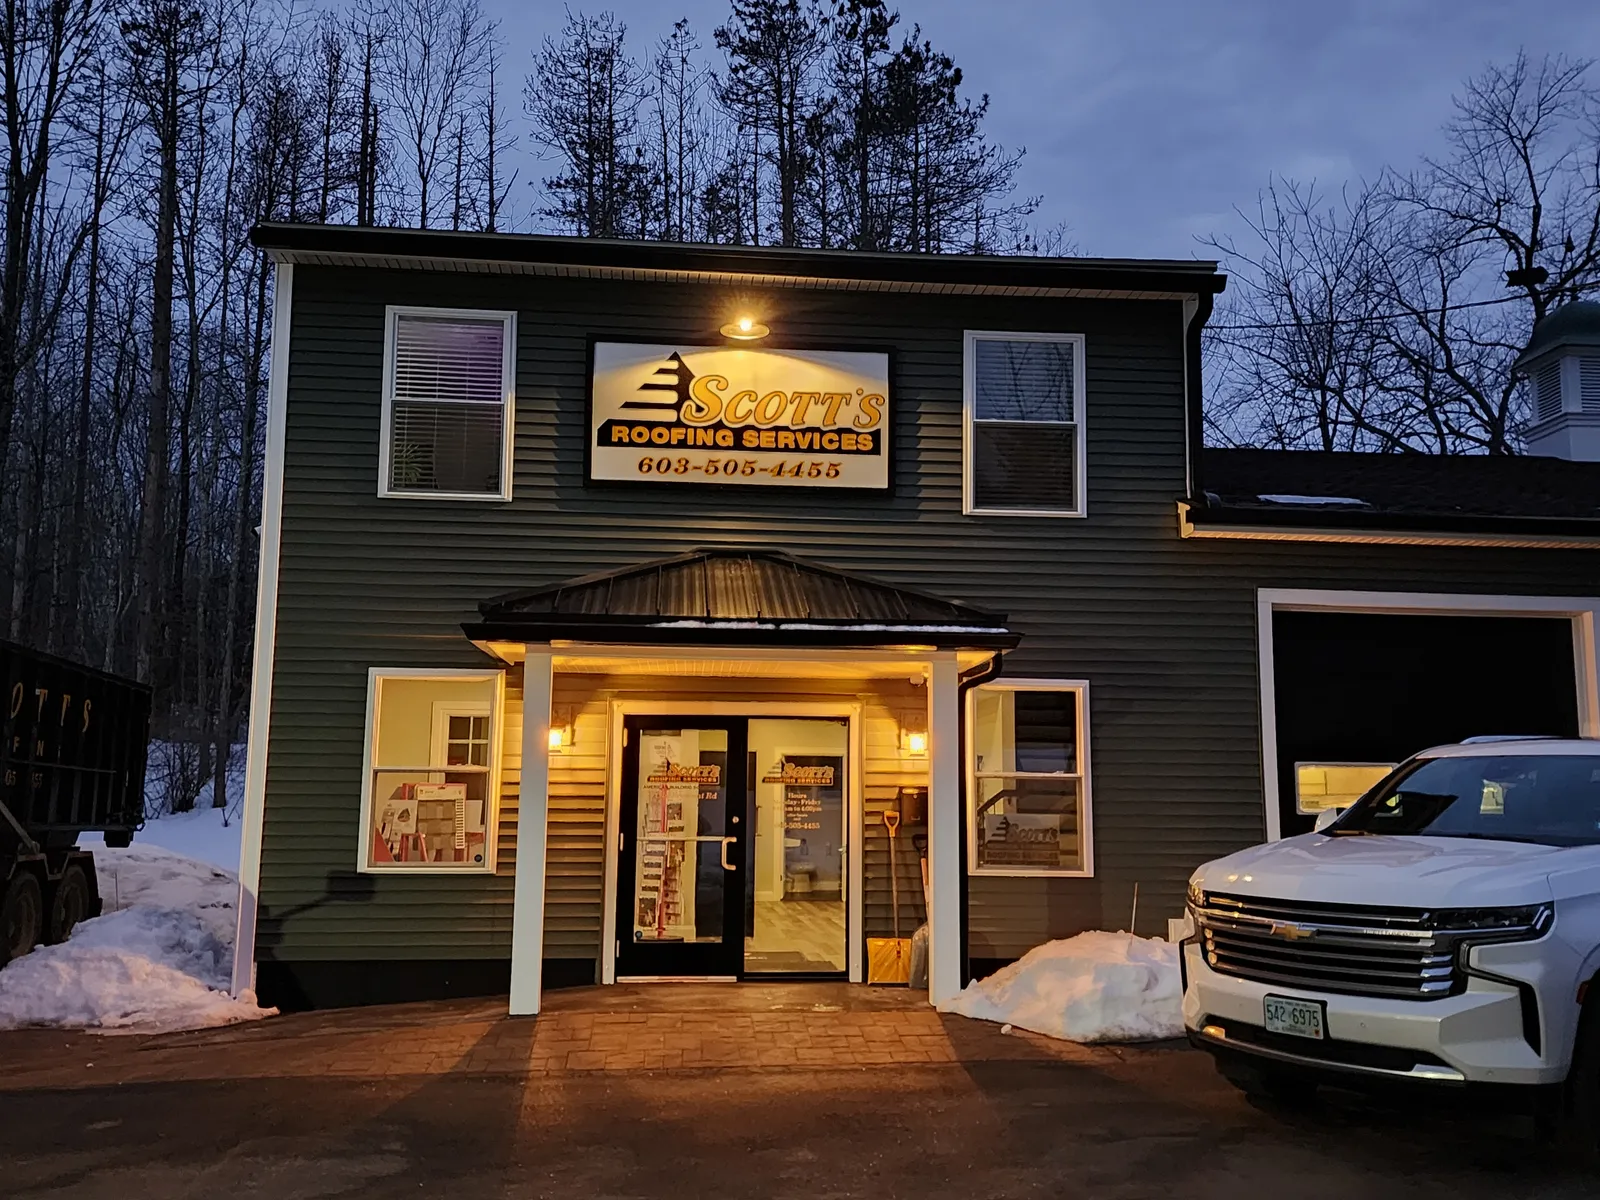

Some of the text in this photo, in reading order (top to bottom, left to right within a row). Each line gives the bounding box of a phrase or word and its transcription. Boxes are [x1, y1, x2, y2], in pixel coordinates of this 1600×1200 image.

[683, 375, 885, 428] SCOTT'S
[611, 425, 873, 450] ROOFING SERVICES
[637, 457, 842, 479] 603-505-4455
[1266, 1004, 1286, 1022] 542
